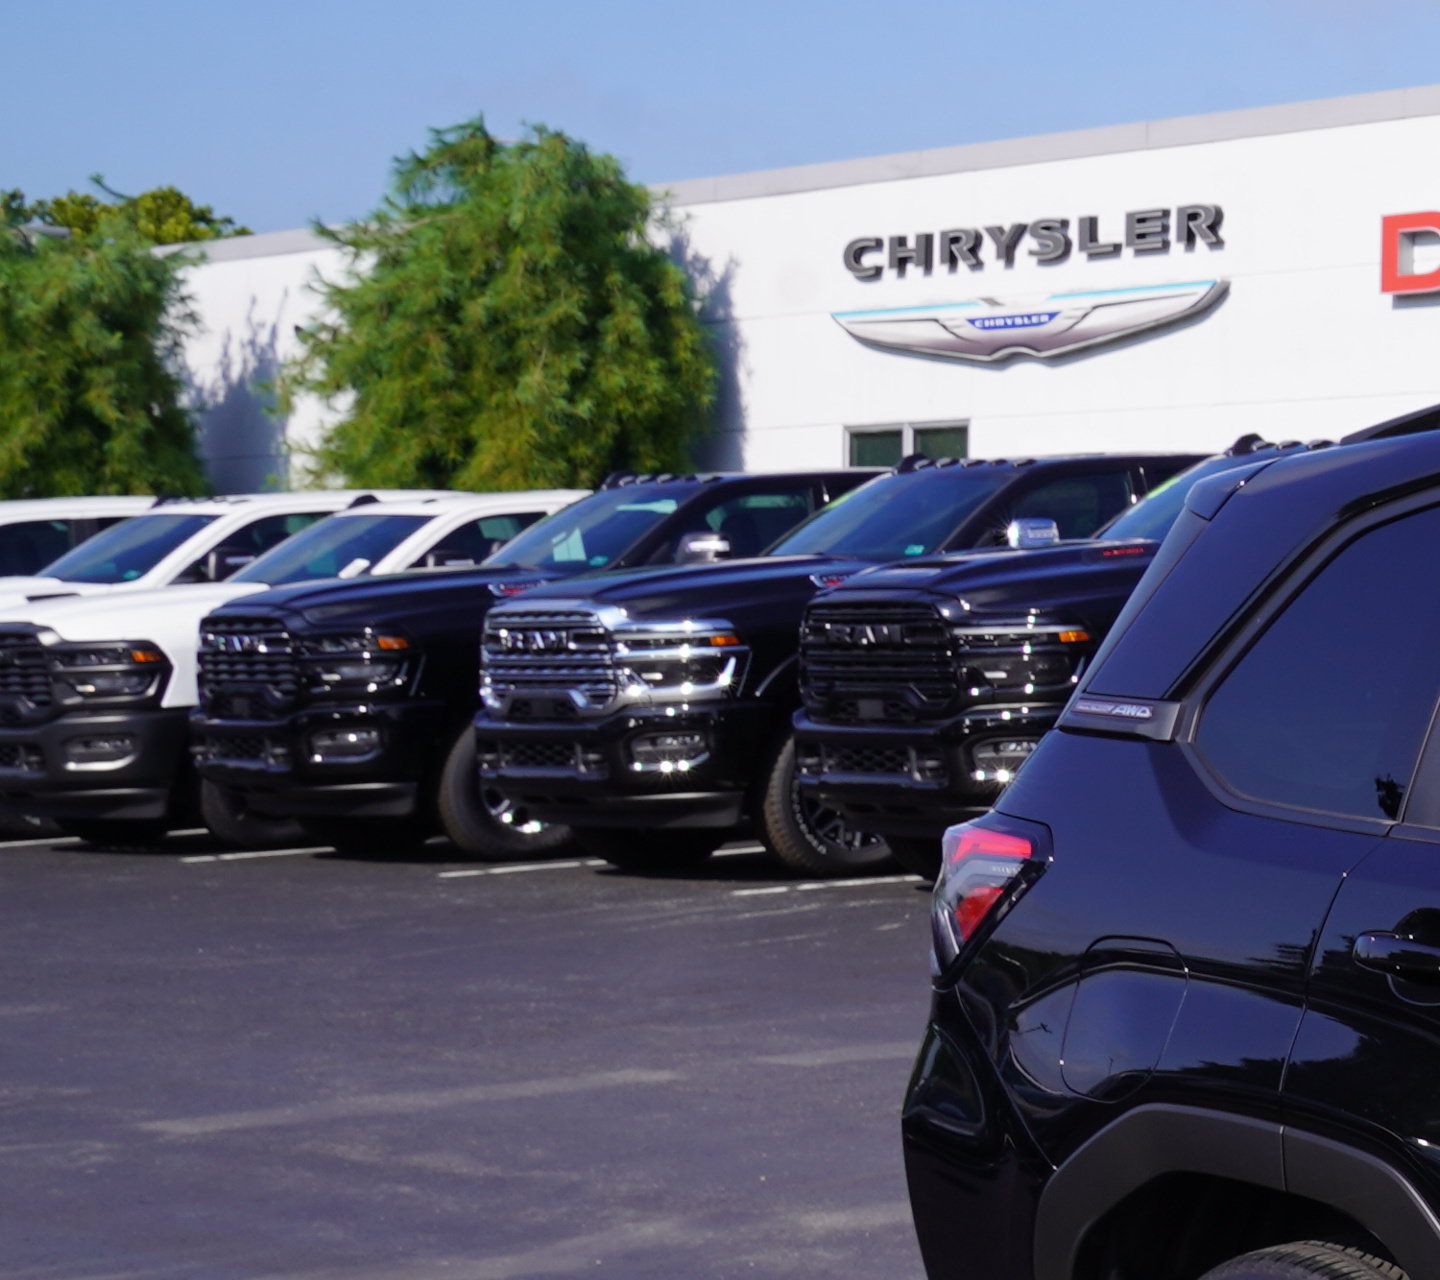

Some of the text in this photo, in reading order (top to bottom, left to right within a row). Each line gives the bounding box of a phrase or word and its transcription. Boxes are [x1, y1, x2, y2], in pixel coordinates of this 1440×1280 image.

[842, 204, 1224, 281] CHRYSLER
[974, 314, 1050, 329] CHRYSLER
[1111, 704, 1153, 718] AWD
